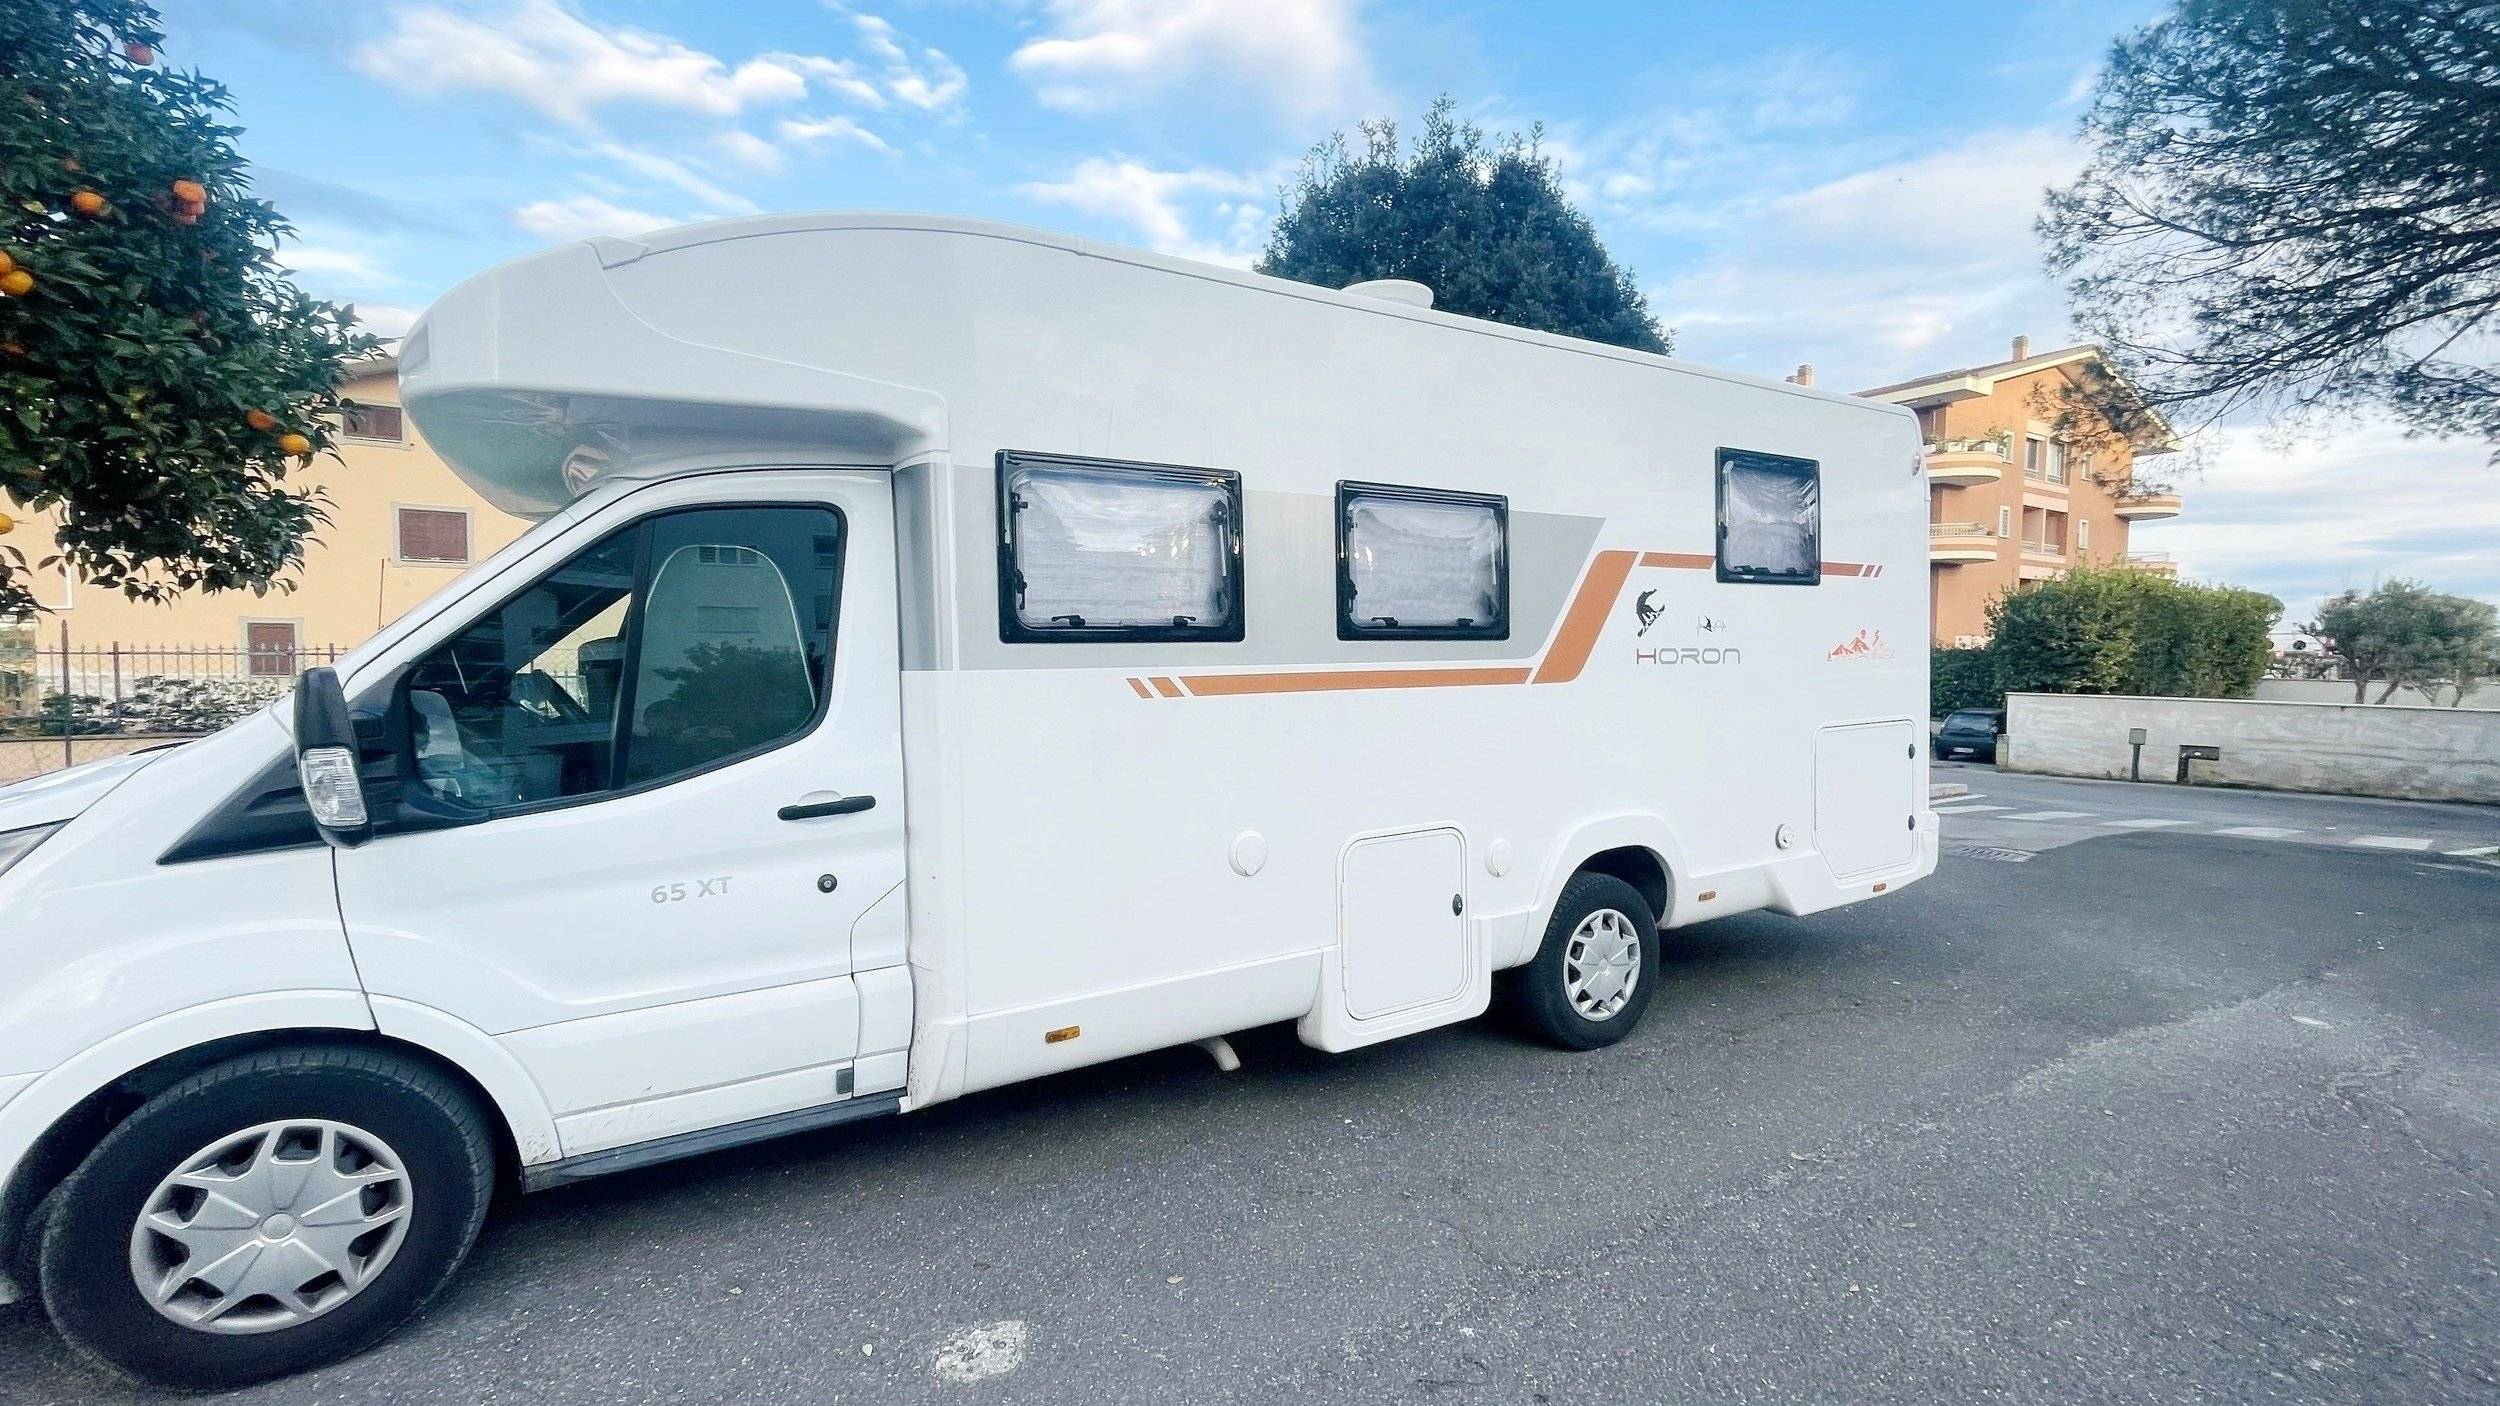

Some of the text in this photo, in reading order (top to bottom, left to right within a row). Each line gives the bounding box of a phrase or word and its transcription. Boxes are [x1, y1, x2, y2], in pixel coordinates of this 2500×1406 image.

[1636, 647, 1741, 665] HORON
[651, 876, 733, 904] 65 XT
